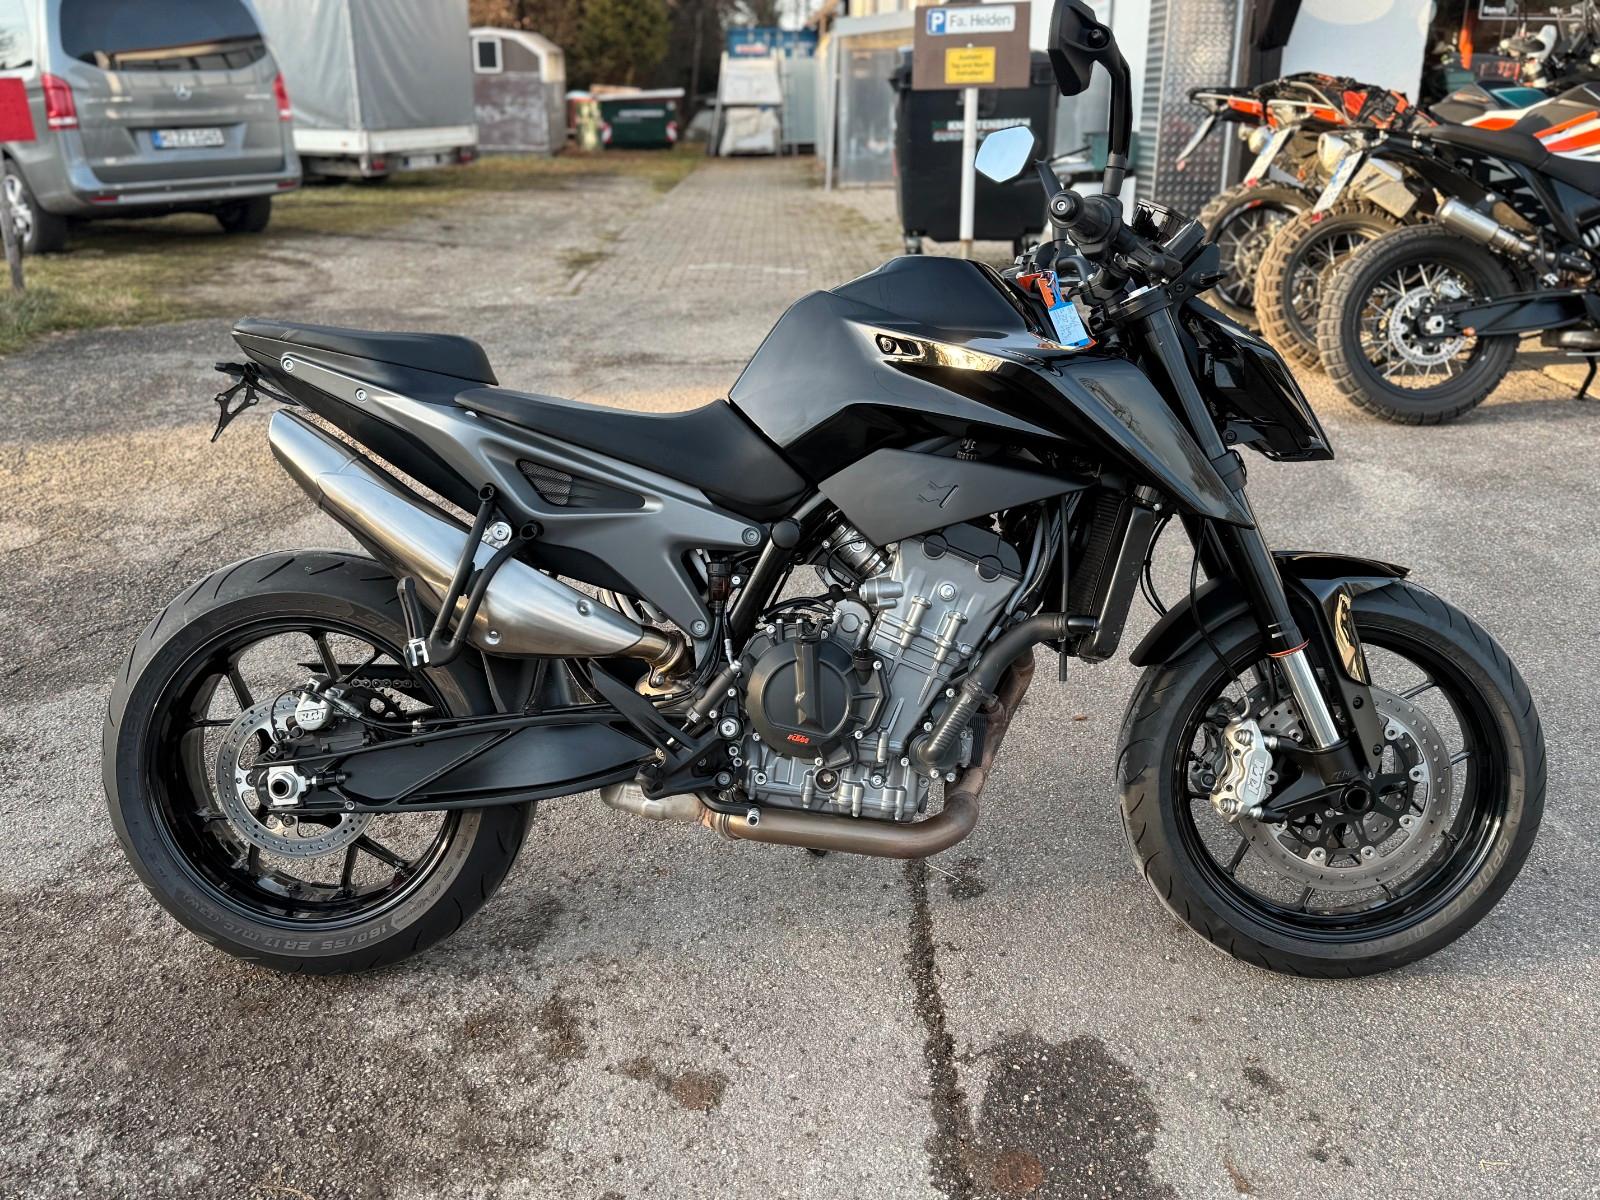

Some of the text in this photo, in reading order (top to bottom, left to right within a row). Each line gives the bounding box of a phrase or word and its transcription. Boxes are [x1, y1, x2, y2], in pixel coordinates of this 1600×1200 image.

[950, 13, 967, 27] Fa.
[970, 11, 1011, 27] Heiden
[786, 733, 810, 744] KTM
[1247, 758, 1266, 796] KTM
